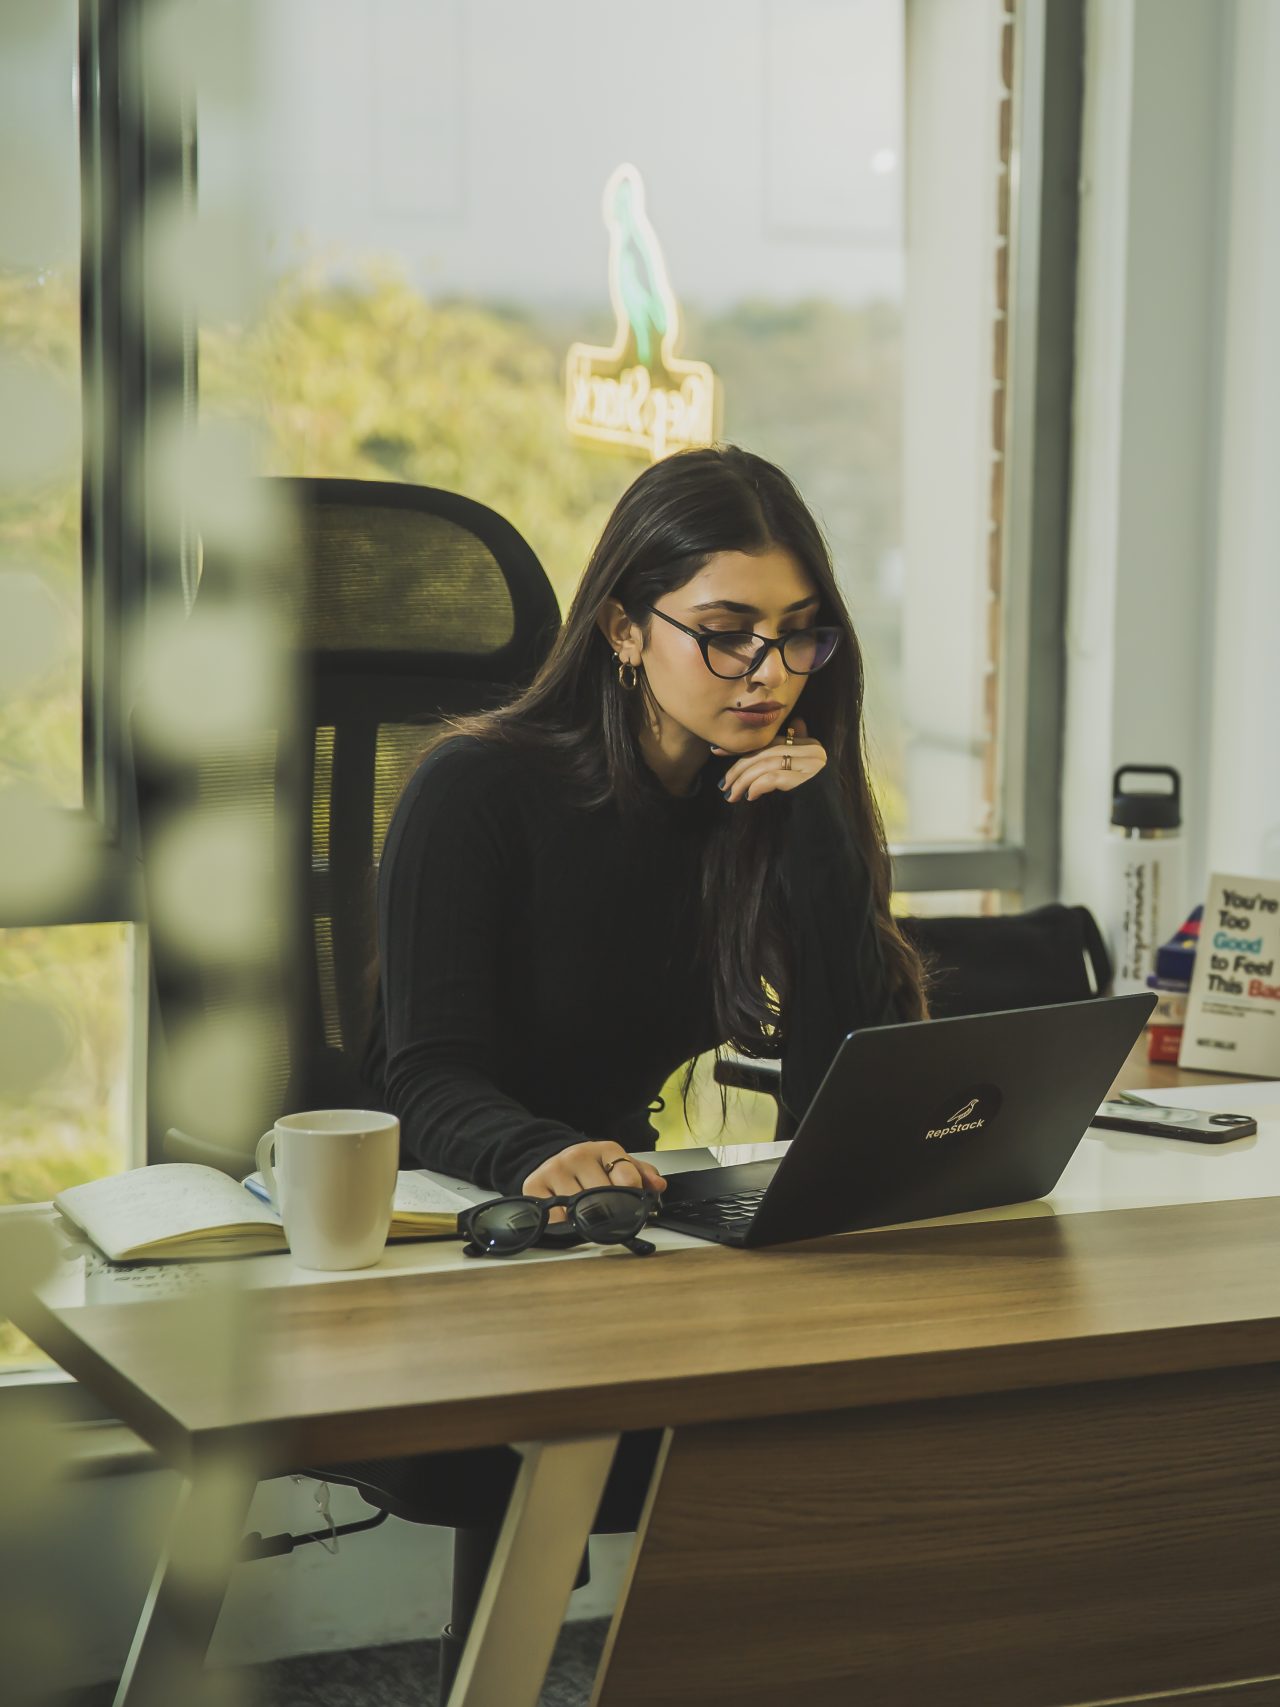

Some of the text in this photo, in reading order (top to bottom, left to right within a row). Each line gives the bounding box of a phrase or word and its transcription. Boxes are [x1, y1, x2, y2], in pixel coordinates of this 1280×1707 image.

[1223, 889, 1279, 914] You're
[1219, 910, 1251, 931] Too
[1213, 931, 1263, 954] Good
[1211, 954, 1274, 977] to Feel
[1208, 974, 1243, 995] This
[925, 1118, 985, 1140] RepStack
